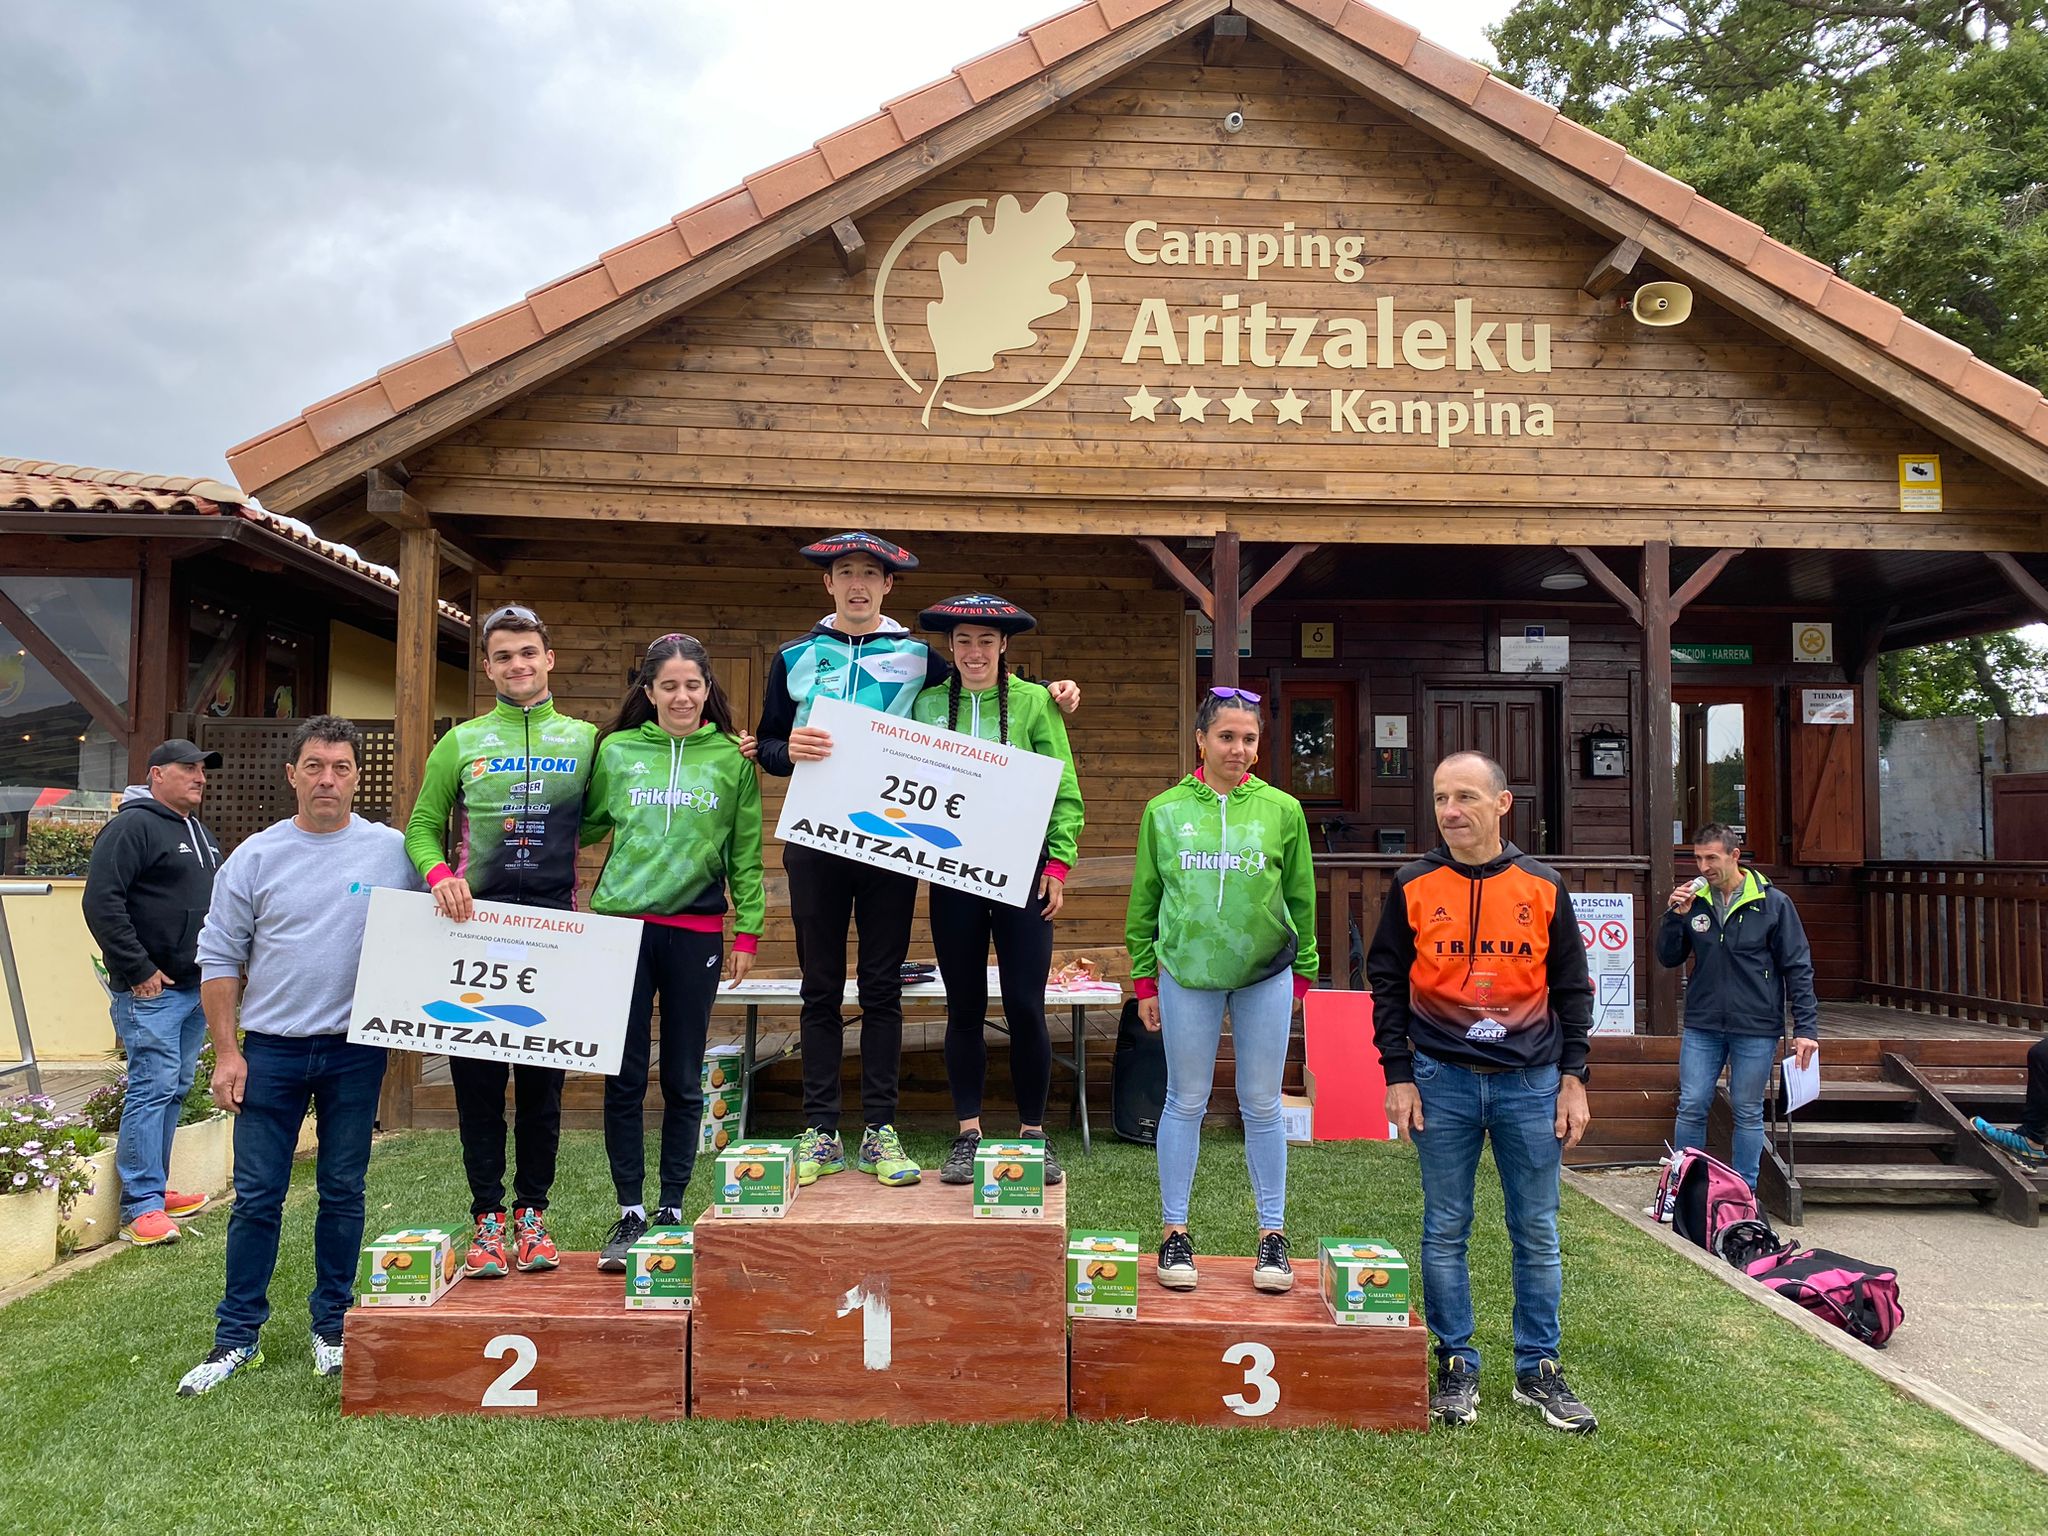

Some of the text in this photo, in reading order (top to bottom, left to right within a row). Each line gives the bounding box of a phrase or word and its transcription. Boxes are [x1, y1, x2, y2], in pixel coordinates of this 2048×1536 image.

[1124, 219, 1365, 283] Camping
[1122, 294, 1552, 375] Aritzaleku
[1330, 388, 1554, 448] Kanpina
[1712, 649, 1750, 660] HARRERA
[1812, 692, 1843, 700] TIENDA
[488, 756, 577, 774] SALTOKI
[870, 720, 1009, 767] TRIATLON ARITZALEKU
[888, 749, 922, 762] CLASIFICADO
[951, 766, 982, 778] MASCULINA
[880, 775, 966, 819] 250 €
[788, 833, 1005, 898] TRIATLON TRIATLOIA
[790, 817, 1009, 888] ARITZALEKU
[433, 905, 585, 935] TRLON ARITZALEKU
[1581, 899, 1624, 907] PISCINA
[457, 932, 493, 942] CLASIFICADO
[525, 941, 559, 950] MASCULINA
[450, 959, 538, 993] 125 €
[360, 1034, 597, 1068] TRIATLON TRIATLOIA
[361, 1016, 599, 1058] ARITZALEKU
[836, 1283, 892, 1370] 1
[481, 1334, 538, 1407] 2
[1221, 1342, 1281, 1417] 3
